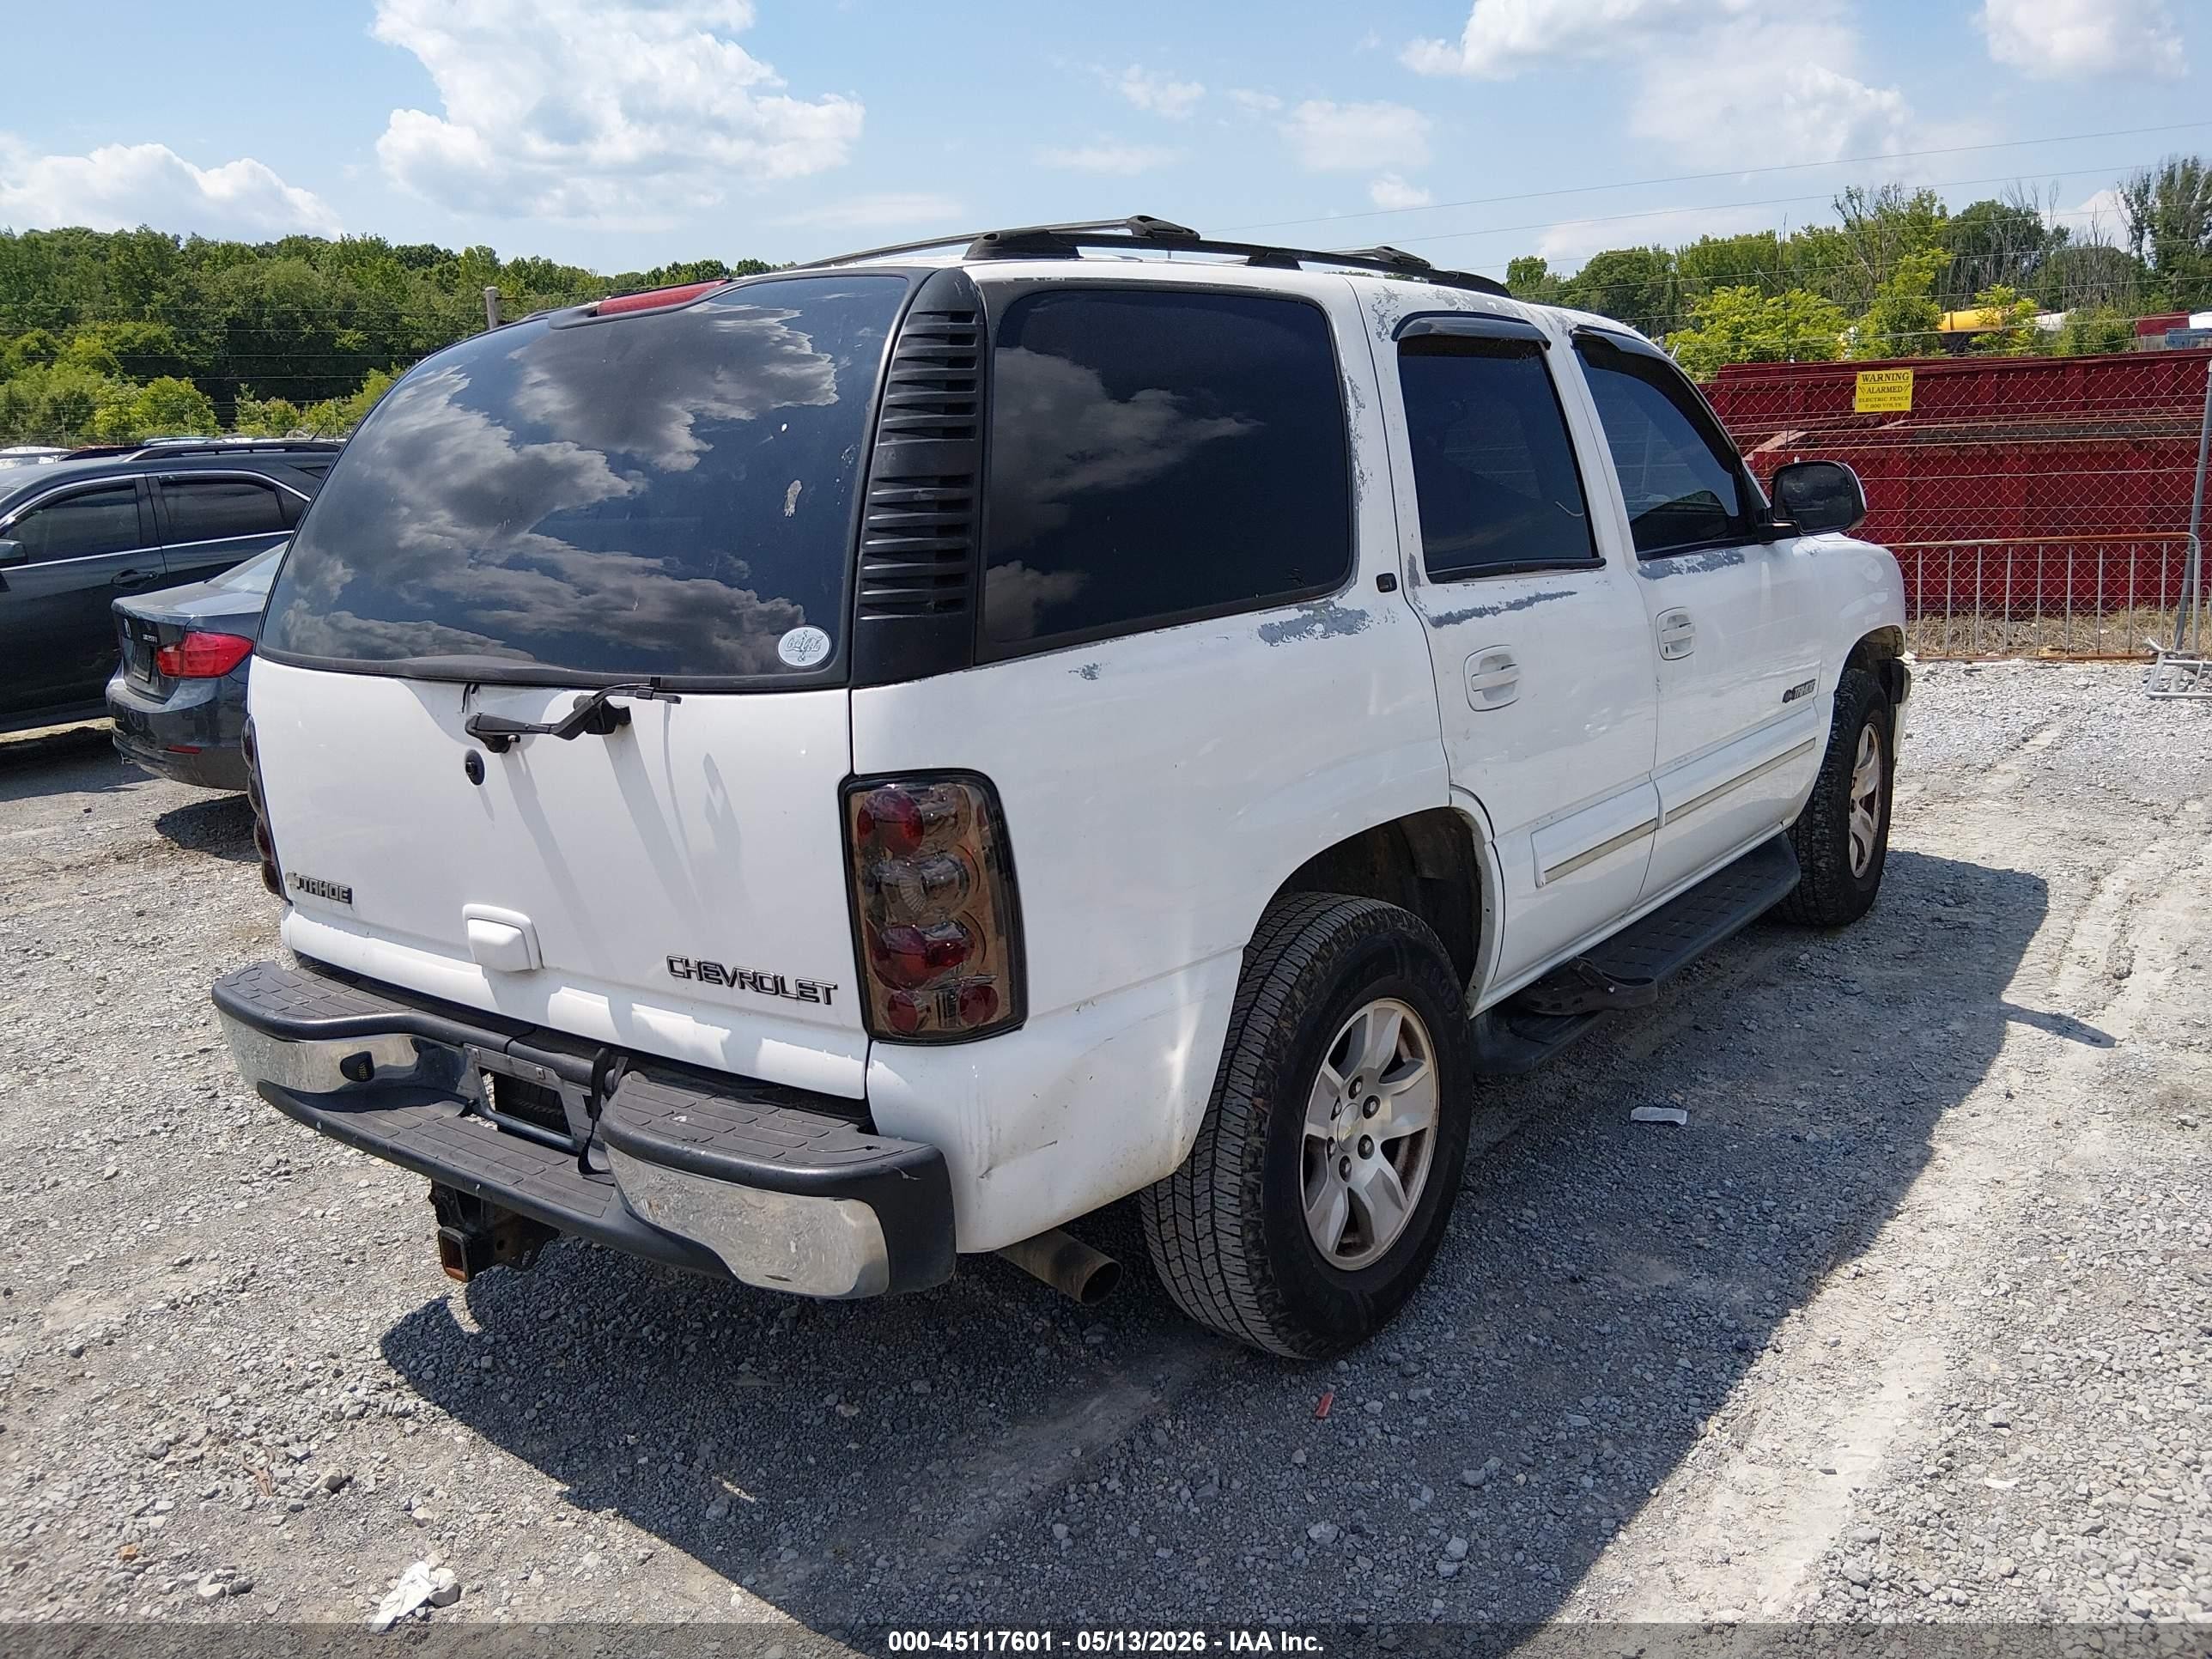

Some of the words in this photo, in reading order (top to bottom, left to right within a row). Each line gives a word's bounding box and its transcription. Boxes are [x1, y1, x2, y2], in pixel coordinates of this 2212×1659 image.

[1862, 373, 1910, 382] WARNING
[1867, 386, 1903, 394] ALARMED
[300, 875, 352, 904] TAHOE
[666, 954, 838, 1006] CHEVROLET
